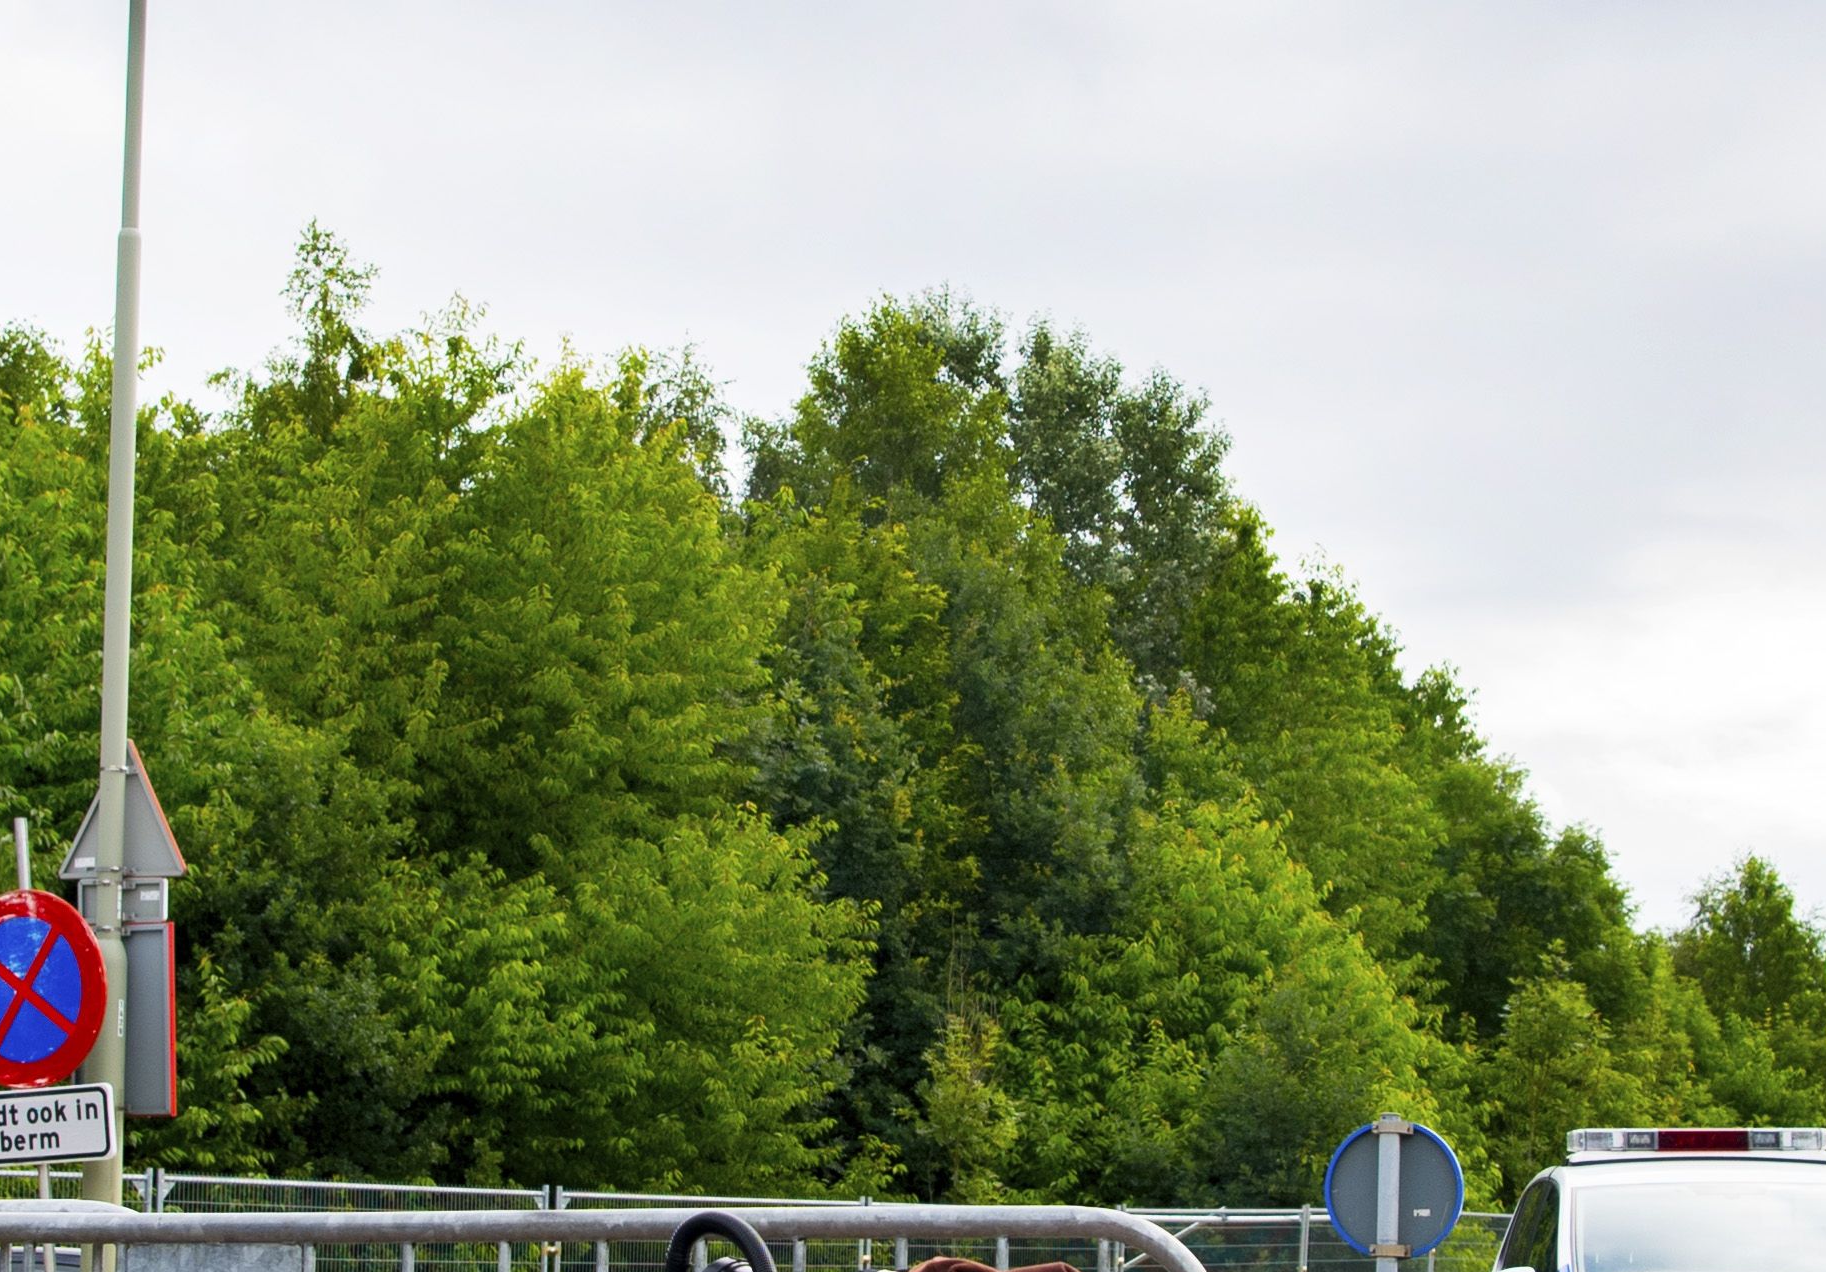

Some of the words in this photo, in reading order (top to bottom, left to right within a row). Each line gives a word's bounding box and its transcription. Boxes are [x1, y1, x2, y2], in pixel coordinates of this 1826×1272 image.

[26, 1100, 68, 1125] ook
[76, 1098, 99, 1121] in
[0, 1130, 61, 1153] berm
